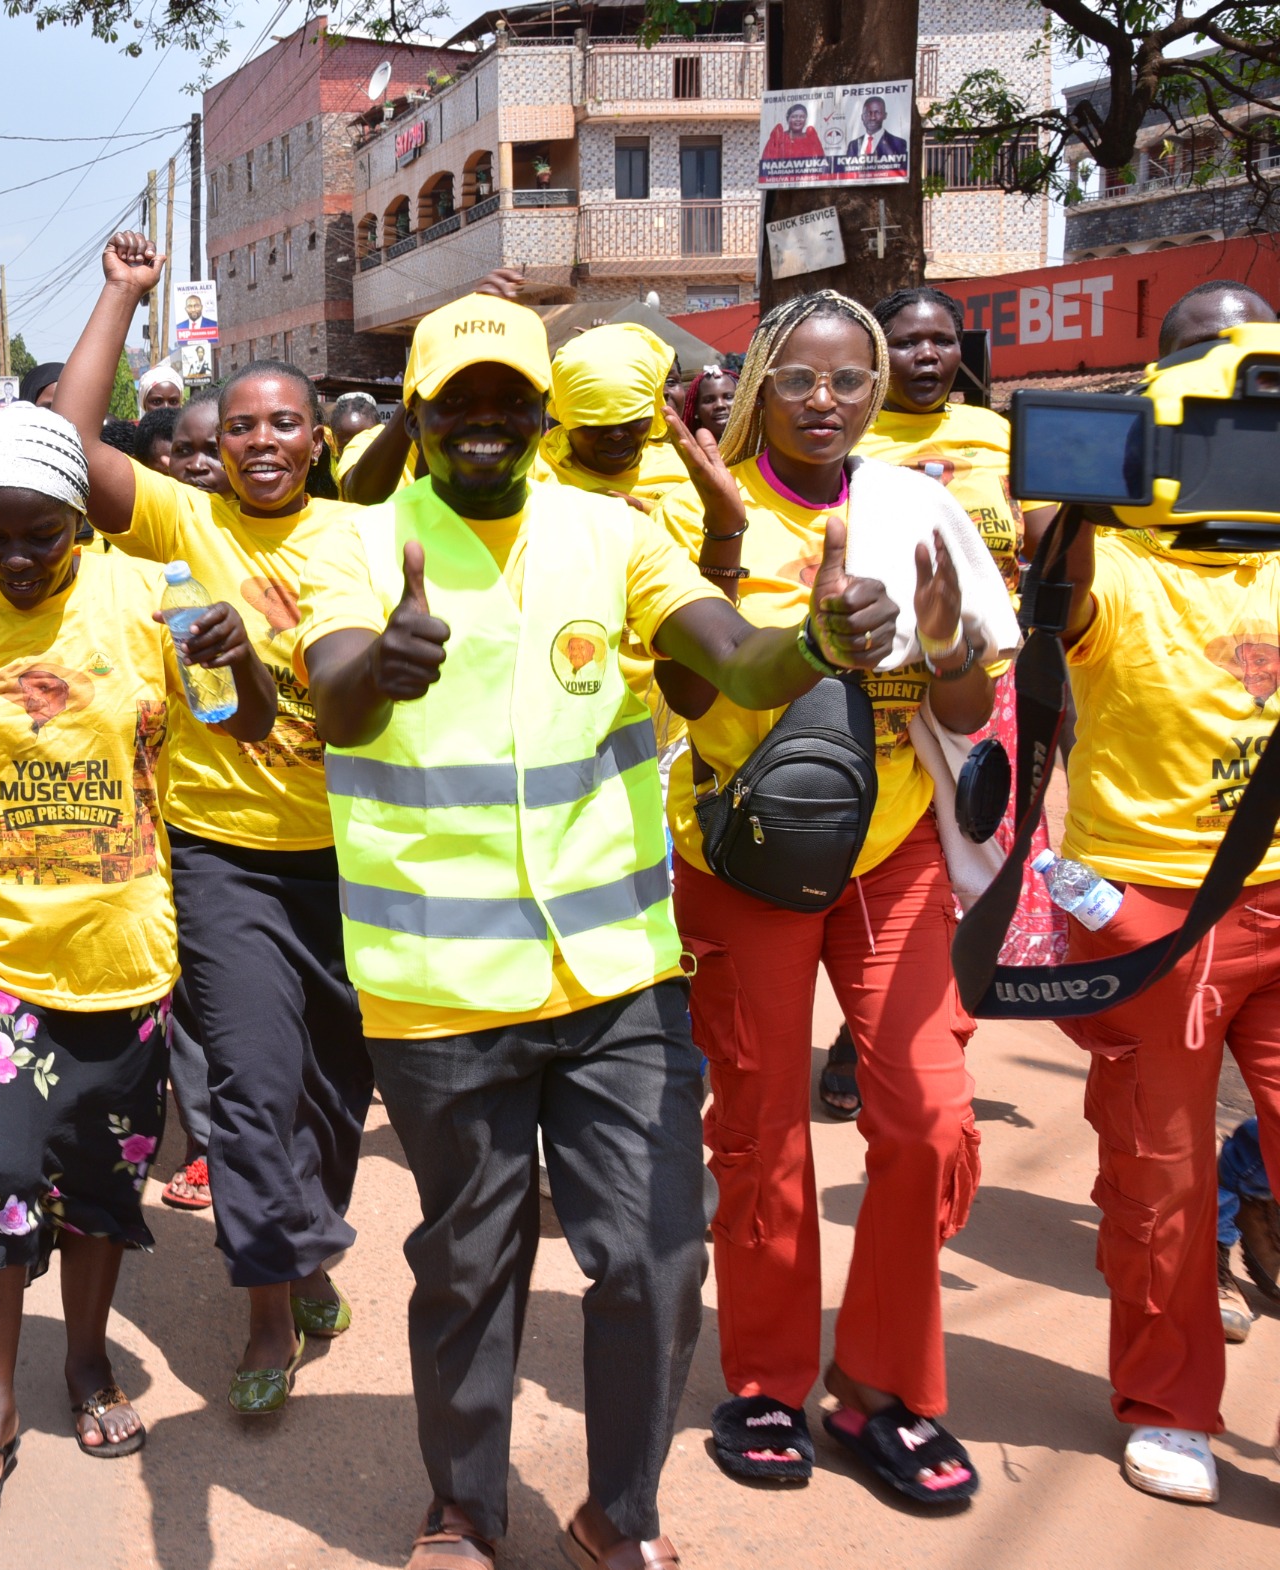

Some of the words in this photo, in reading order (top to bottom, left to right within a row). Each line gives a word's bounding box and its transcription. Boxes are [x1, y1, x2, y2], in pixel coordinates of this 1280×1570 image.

[764, 95, 786, 104] WOMAN
[842, 85, 908, 97] PRESIDENT
[762, 158, 829, 170] NAKAWUKA
[837, 154, 907, 165] KYAGULANYI
[770, 218, 797, 233] QUICK
[799, 208, 836, 226] SERVICE
[178, 330, 191, 339] MP
[454, 320, 506, 338] NRM
[12, 759, 108, 781] YOWERI
[0, 780, 122, 801] MUSEVENI
[1223, 788, 1246, 808] FO
[7, 808, 35, 826] FOR
[38, 804, 117, 825] PRESIDENT
[995, 974, 1120, 1003] Canon
